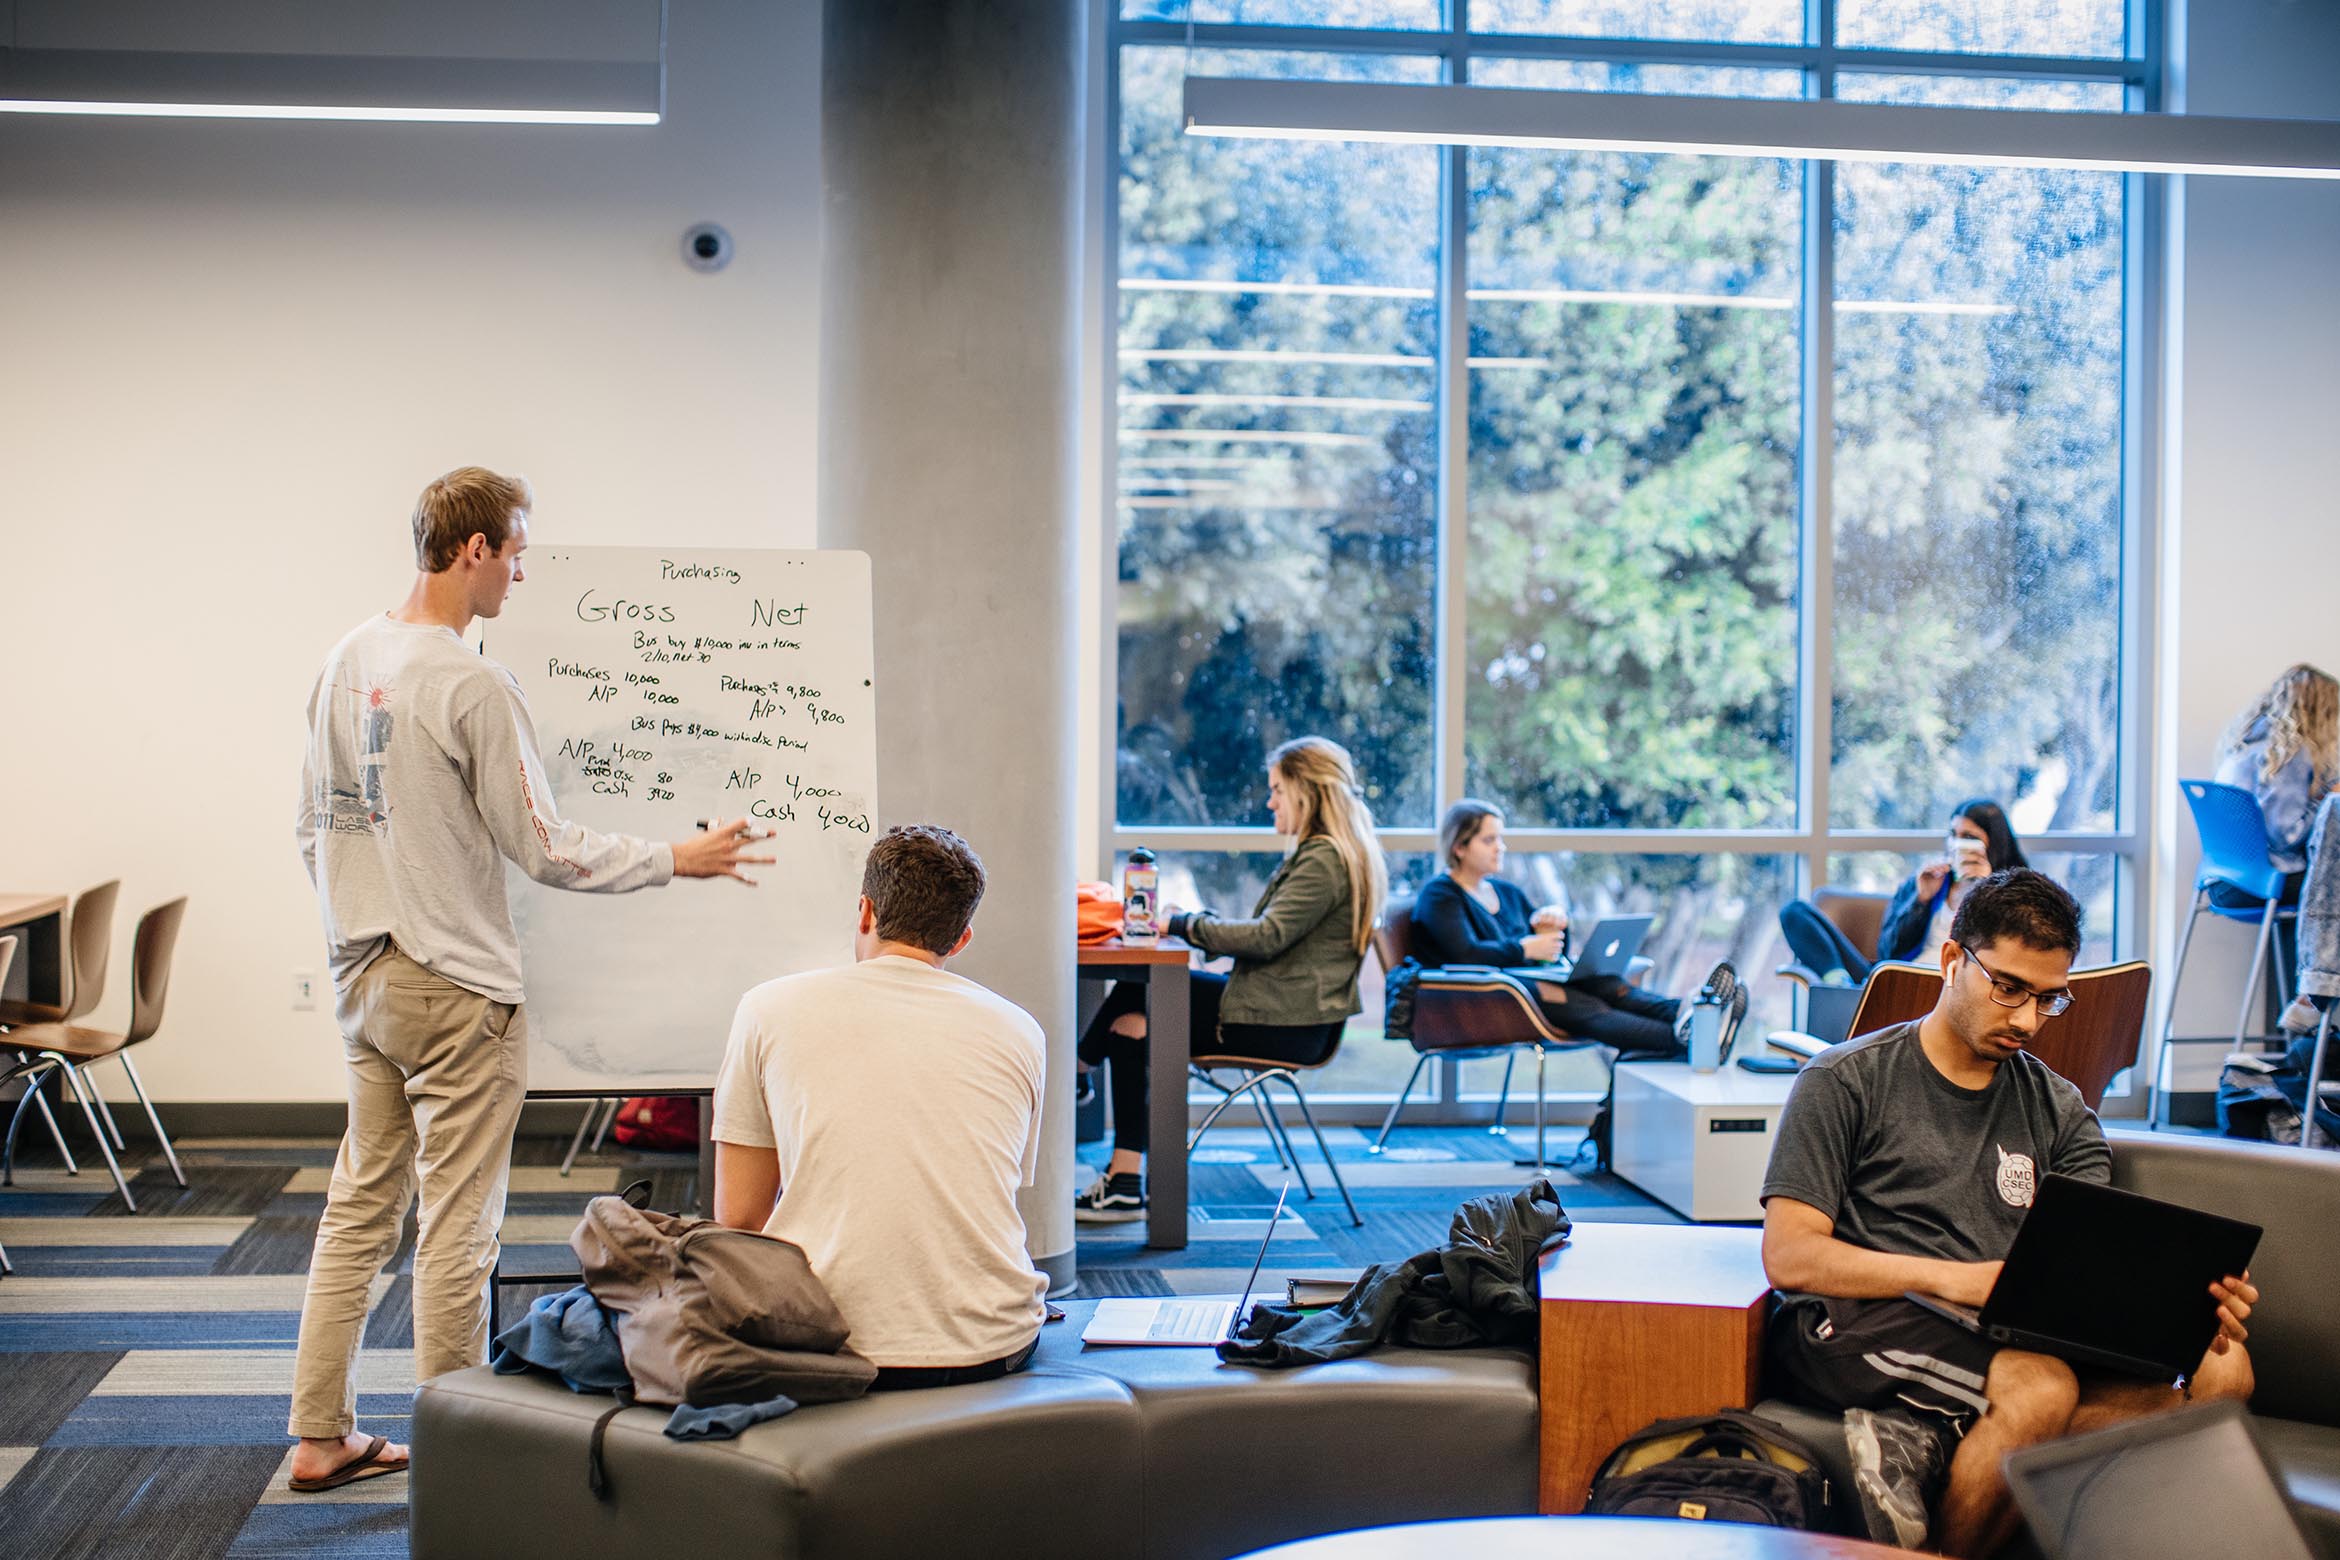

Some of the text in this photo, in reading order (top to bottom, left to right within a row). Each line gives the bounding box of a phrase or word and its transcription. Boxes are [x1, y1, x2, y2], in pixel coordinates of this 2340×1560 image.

[661, 560, 742, 584] Purchasing
[577, 589, 676, 623] Gross
[751, 599, 809, 628] Net
[668, 635, 687, 650] buy
[694, 637, 733, 651] $10,000
[773, 637, 801, 650] terms
[549, 658, 661, 686] Purchases 10,000
[588, 685, 680, 705] A/P 10,000
[786, 685, 822, 700] 9,800
[749, 699, 845, 725] A/P 9,800
[632, 716, 656, 731] Bus
[558, 738, 653, 763] A/P 4,000
[657, 772, 673, 784] 80
[725, 767, 842, 801] A/P 4,000
[592, 781, 675, 801] Cash 3920
[751, 800, 795, 822] Cash
[2002, 1179, 2033, 1190] CSEC
[2005, 1170, 2032, 1181] UMD
